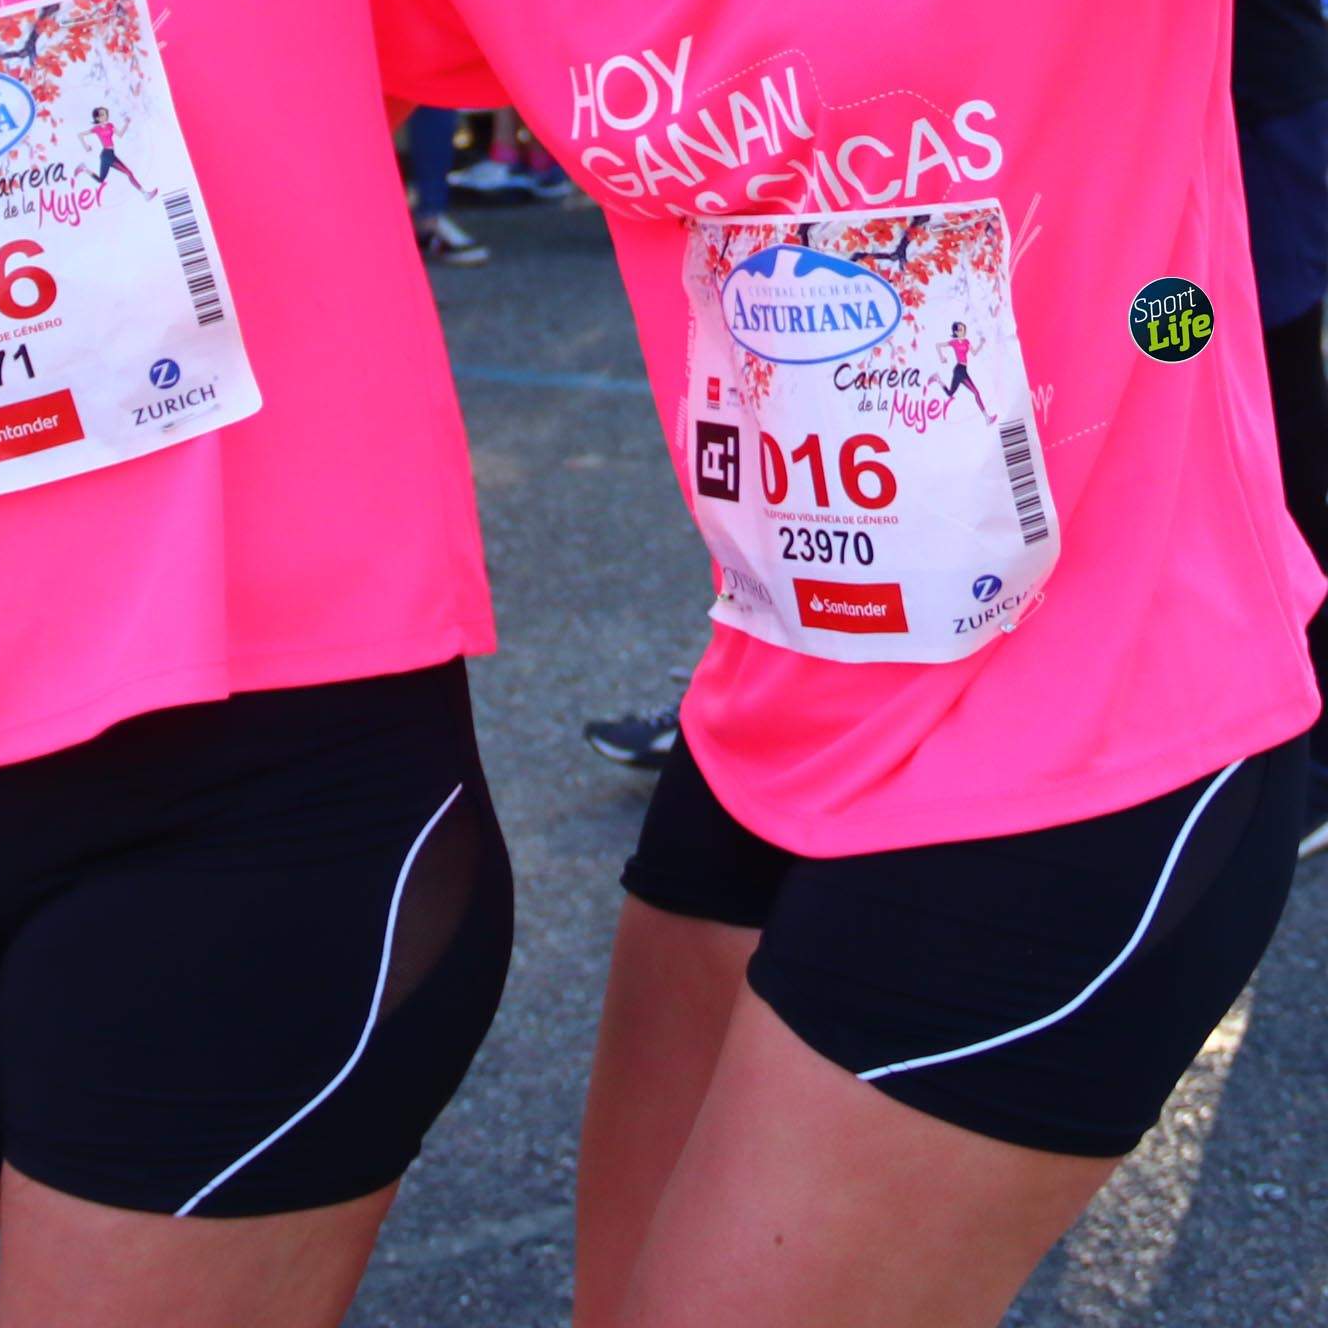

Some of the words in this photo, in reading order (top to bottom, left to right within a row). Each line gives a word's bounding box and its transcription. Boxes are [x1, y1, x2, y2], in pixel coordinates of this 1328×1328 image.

[569, 35, 693, 140] HOY
[580, 67, 815, 199] GANAN
[3, 198, 19, 220] de
[22, 195, 35, 214] la
[38, 177, 107, 230] Mujer
[732, 287, 886, 334] ASTURIANA
[800, 283, 873, 299] LECHERA
[833, 362, 921, 391] Carrera
[131, 383, 217, 427] ZURICH
[857, 393, 873, 412] de
[876, 392, 888, 412] la
[888, 387, 956, 434] Mujer
[759, 430, 898, 511] 016
[797, 512, 841, 524] VIOLENCIA
[841, 515, 855, 525] DE
[778, 526, 875, 566] 23970
[823, 598, 887, 617] Santander
